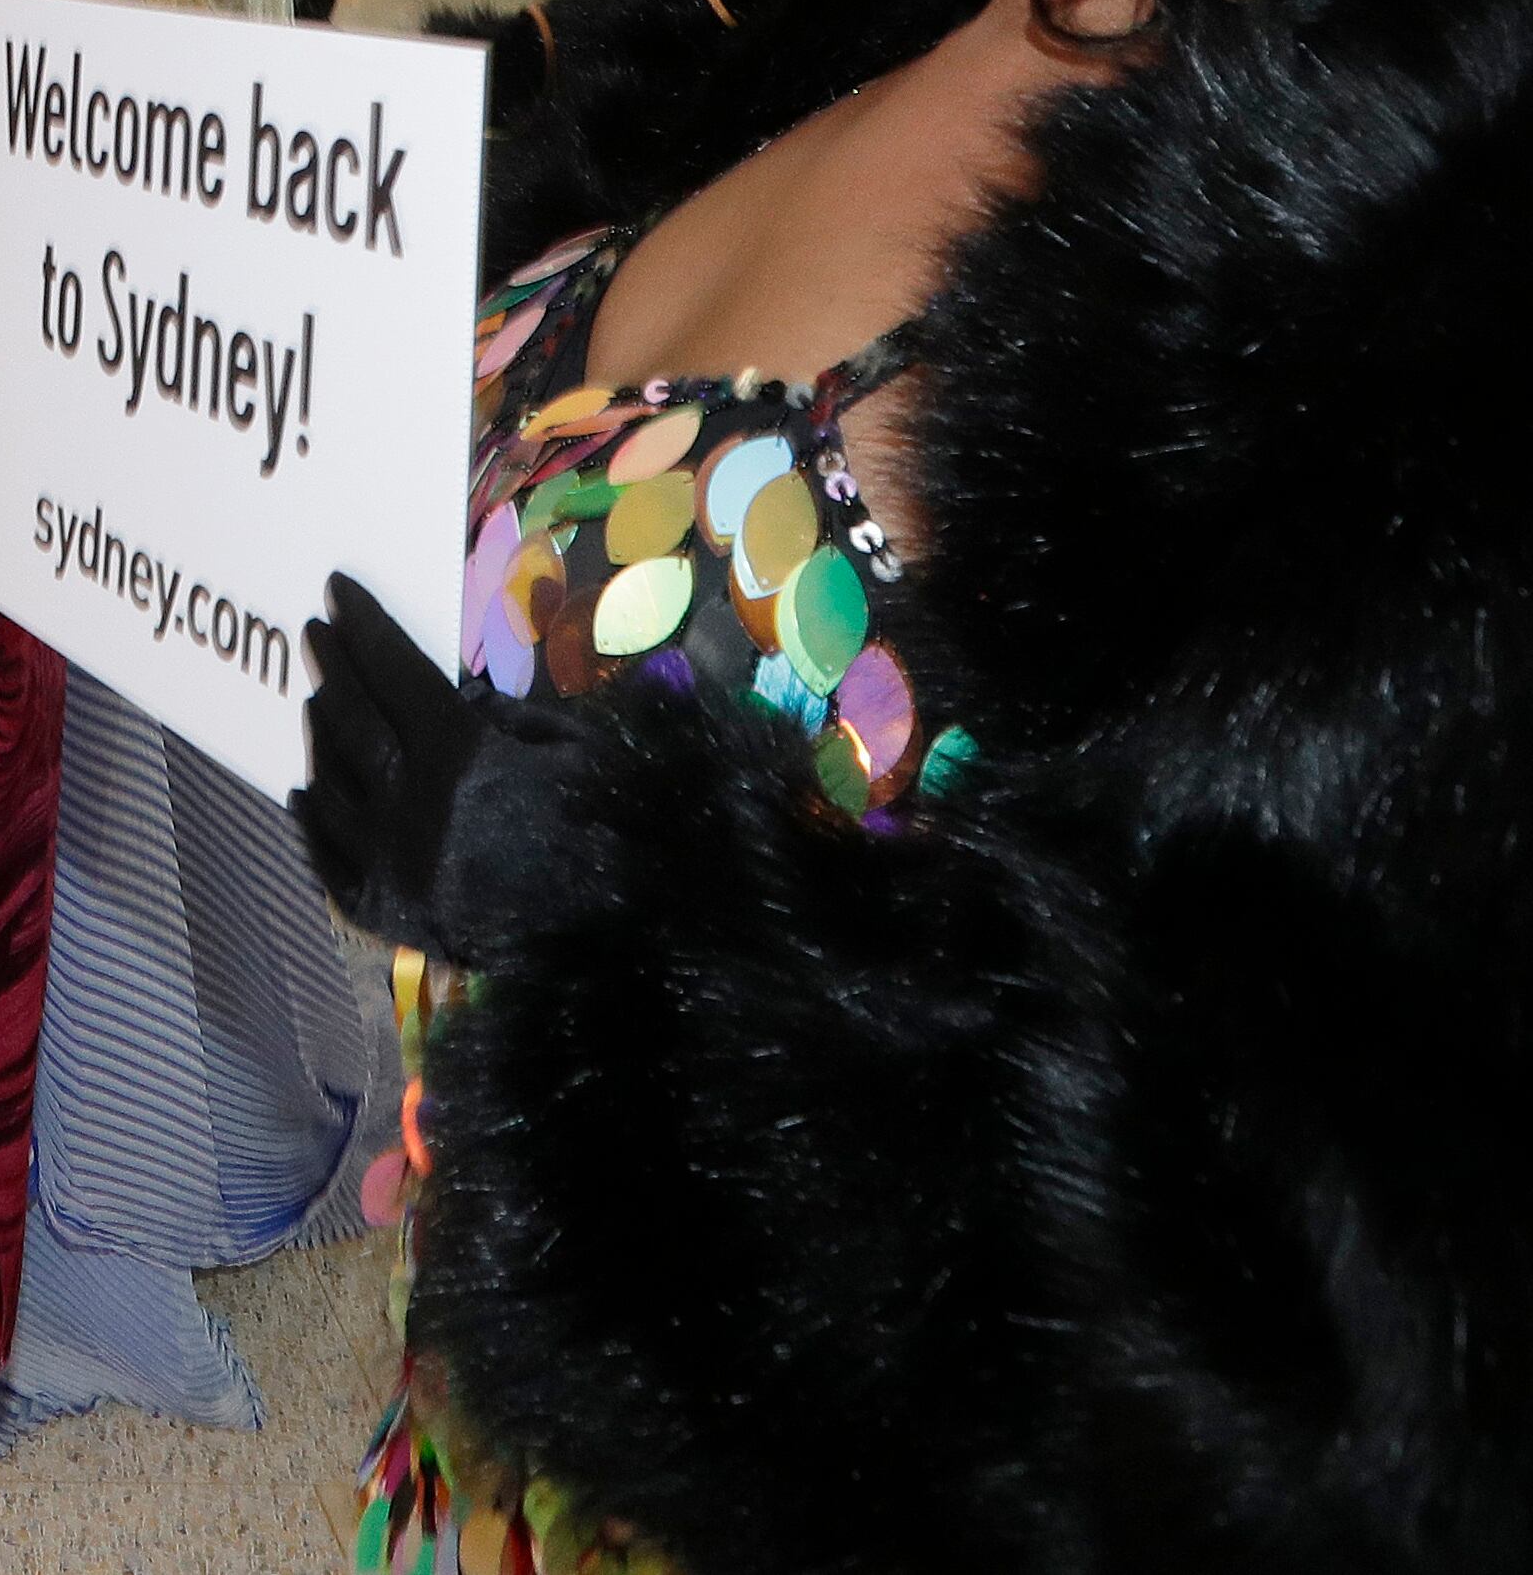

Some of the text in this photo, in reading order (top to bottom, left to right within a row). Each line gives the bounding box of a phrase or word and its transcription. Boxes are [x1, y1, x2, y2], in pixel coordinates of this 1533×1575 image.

[3, 37, 405, 259] Welcome back
[40, 243, 316, 478] to Sydney!
[33, 491, 292, 699] sydney.com
